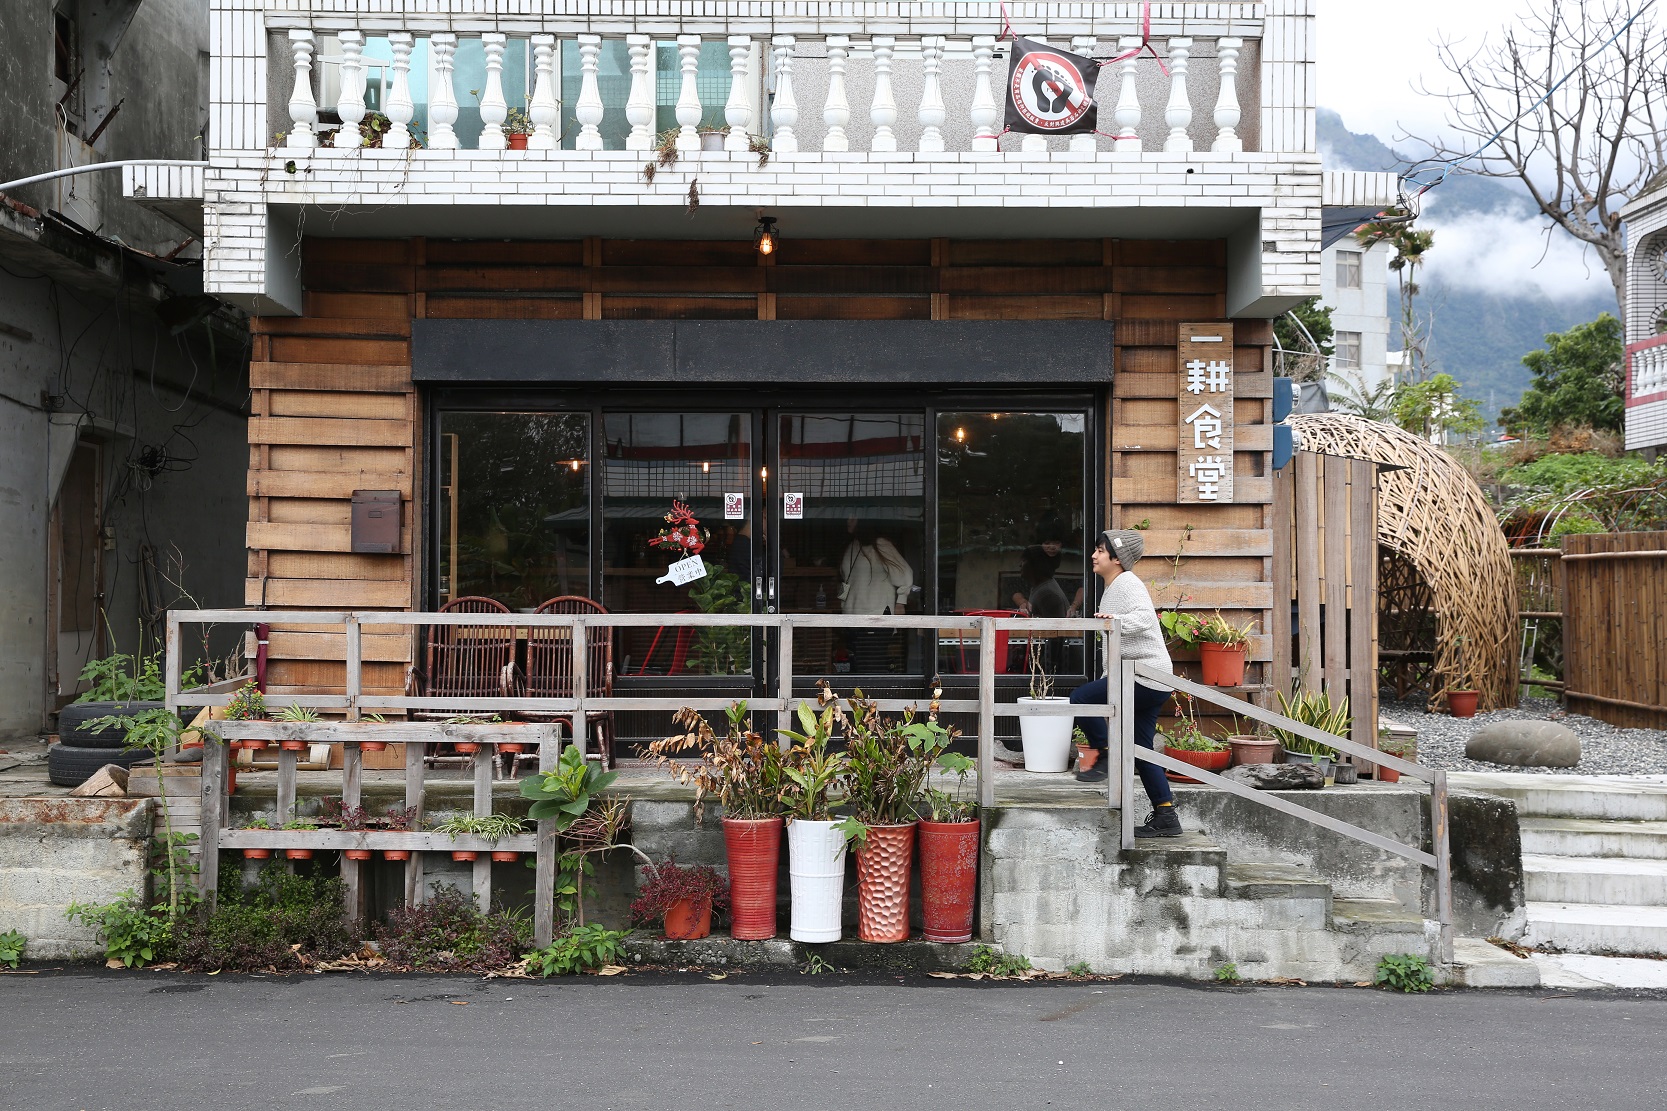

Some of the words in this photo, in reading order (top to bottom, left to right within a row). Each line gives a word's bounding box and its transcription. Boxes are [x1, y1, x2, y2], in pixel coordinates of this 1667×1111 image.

[1185, 336, 1230, 500] 一耕食堂
[674, 558, 699, 573] OPEN
